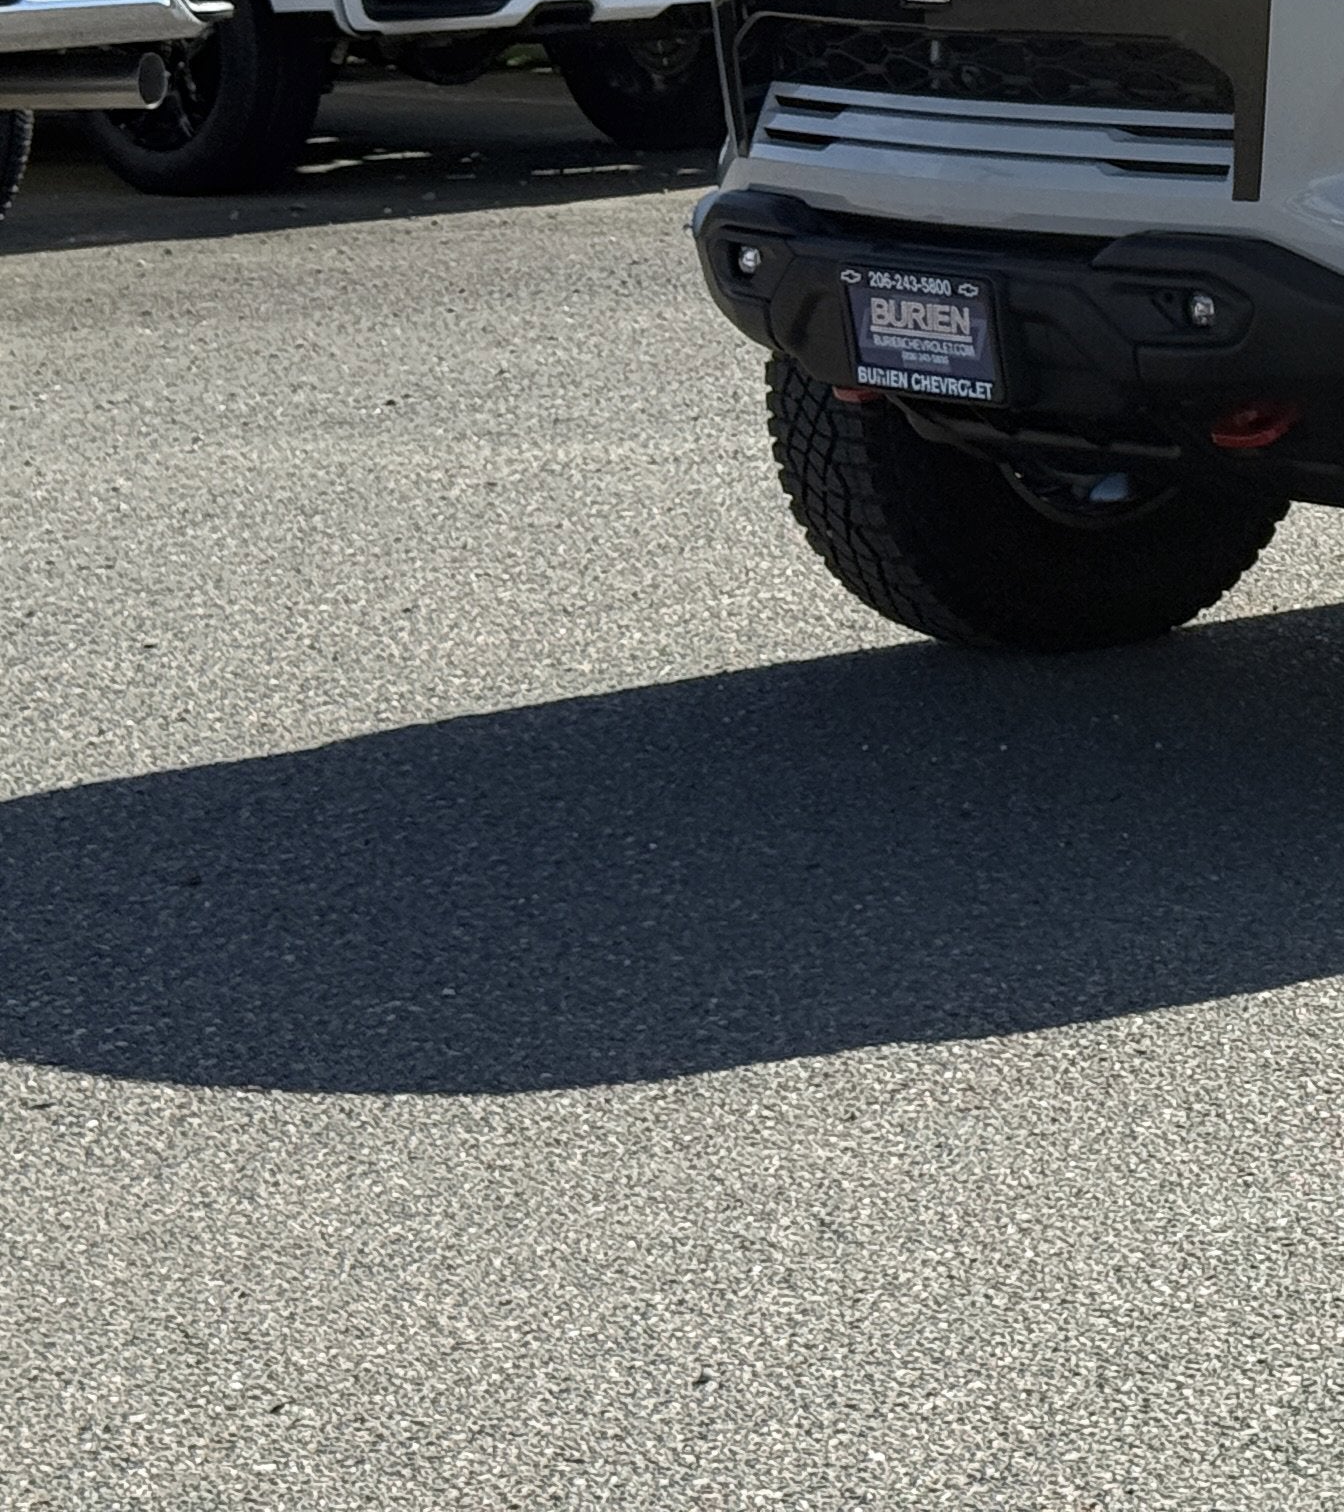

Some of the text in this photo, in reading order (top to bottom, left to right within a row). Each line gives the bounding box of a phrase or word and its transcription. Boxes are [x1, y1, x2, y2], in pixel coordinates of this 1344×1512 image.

[868, 272, 952, 295] 206-243-5800
[870, 297, 971, 335] BURIEN
[857, 366, 993, 400] BURIEN CHEVROLET
